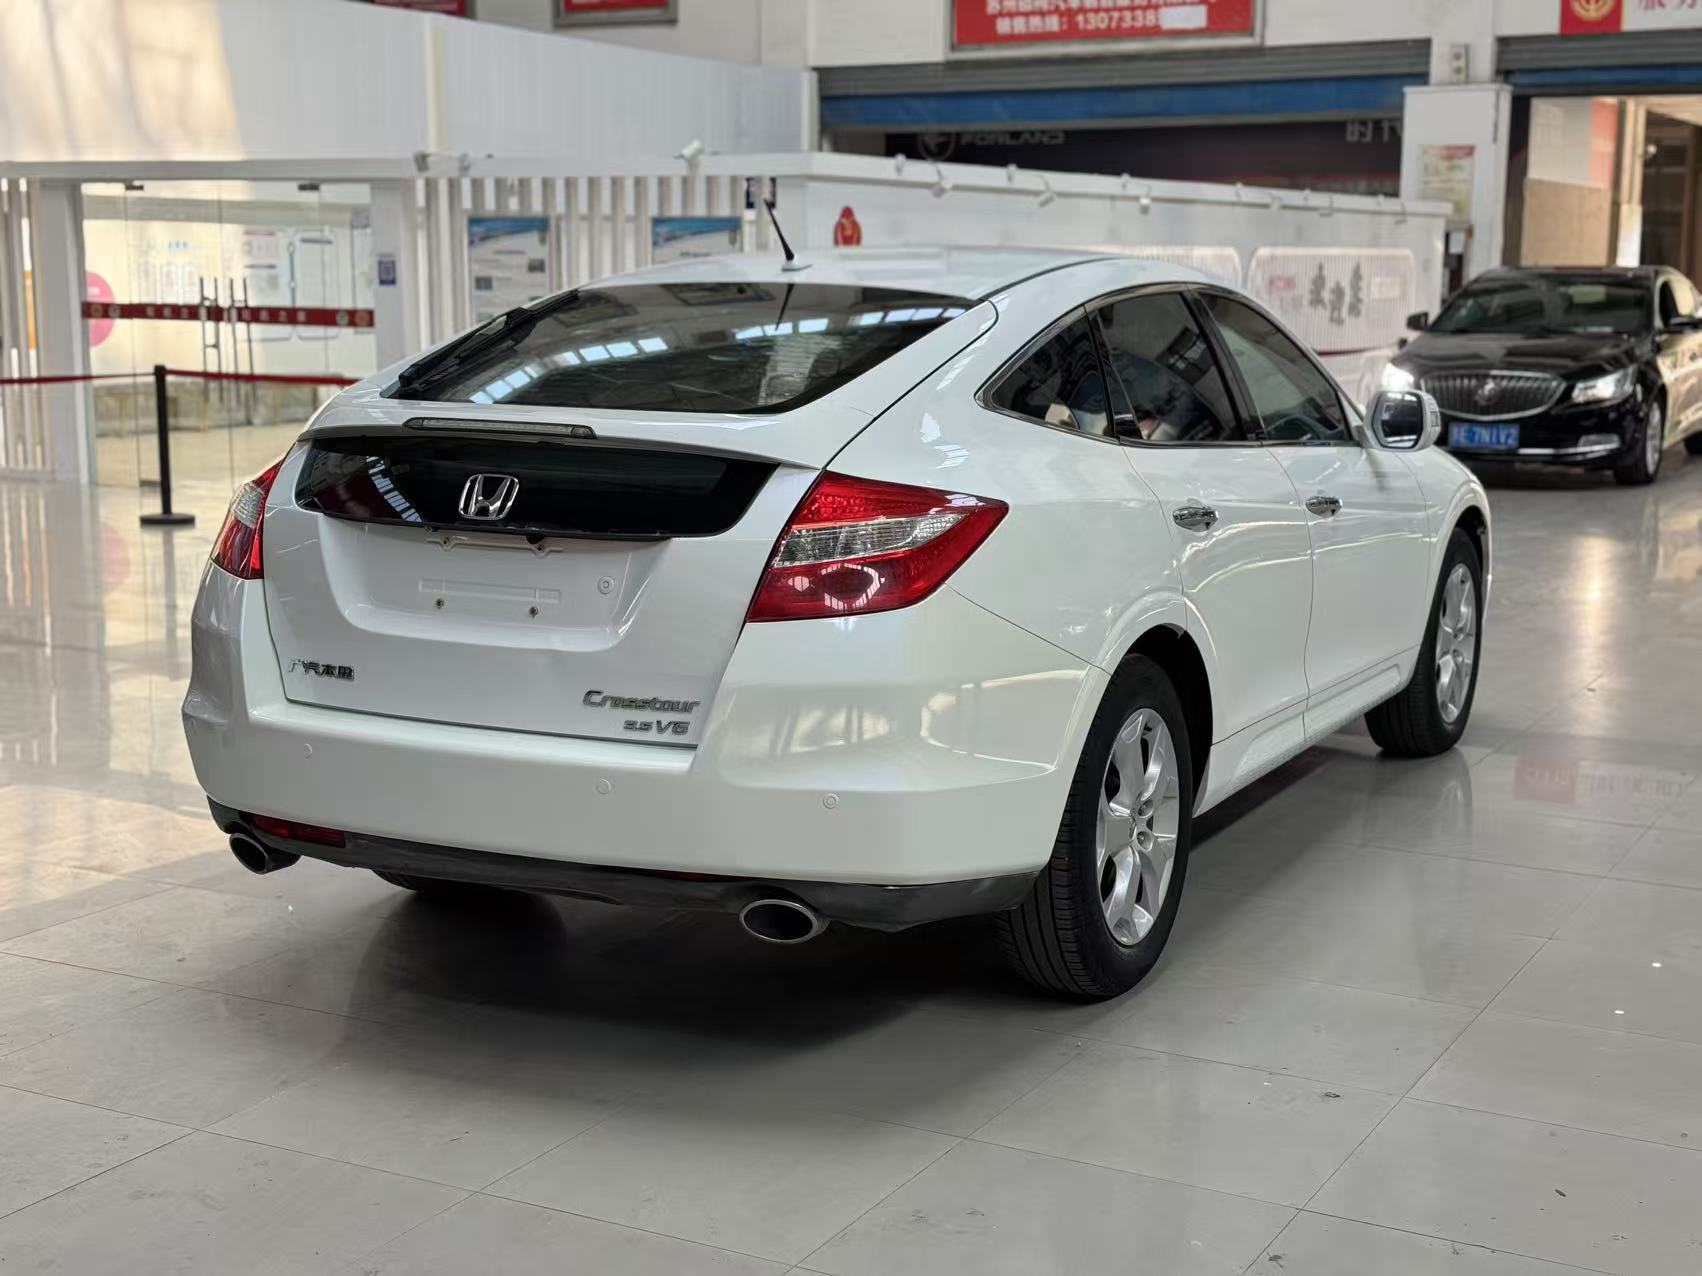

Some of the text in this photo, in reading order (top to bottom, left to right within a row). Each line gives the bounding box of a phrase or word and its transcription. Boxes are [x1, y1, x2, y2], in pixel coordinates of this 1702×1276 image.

[288, 659, 355, 682] 广汽本田
[582, 689, 701, 713] Crosstour
